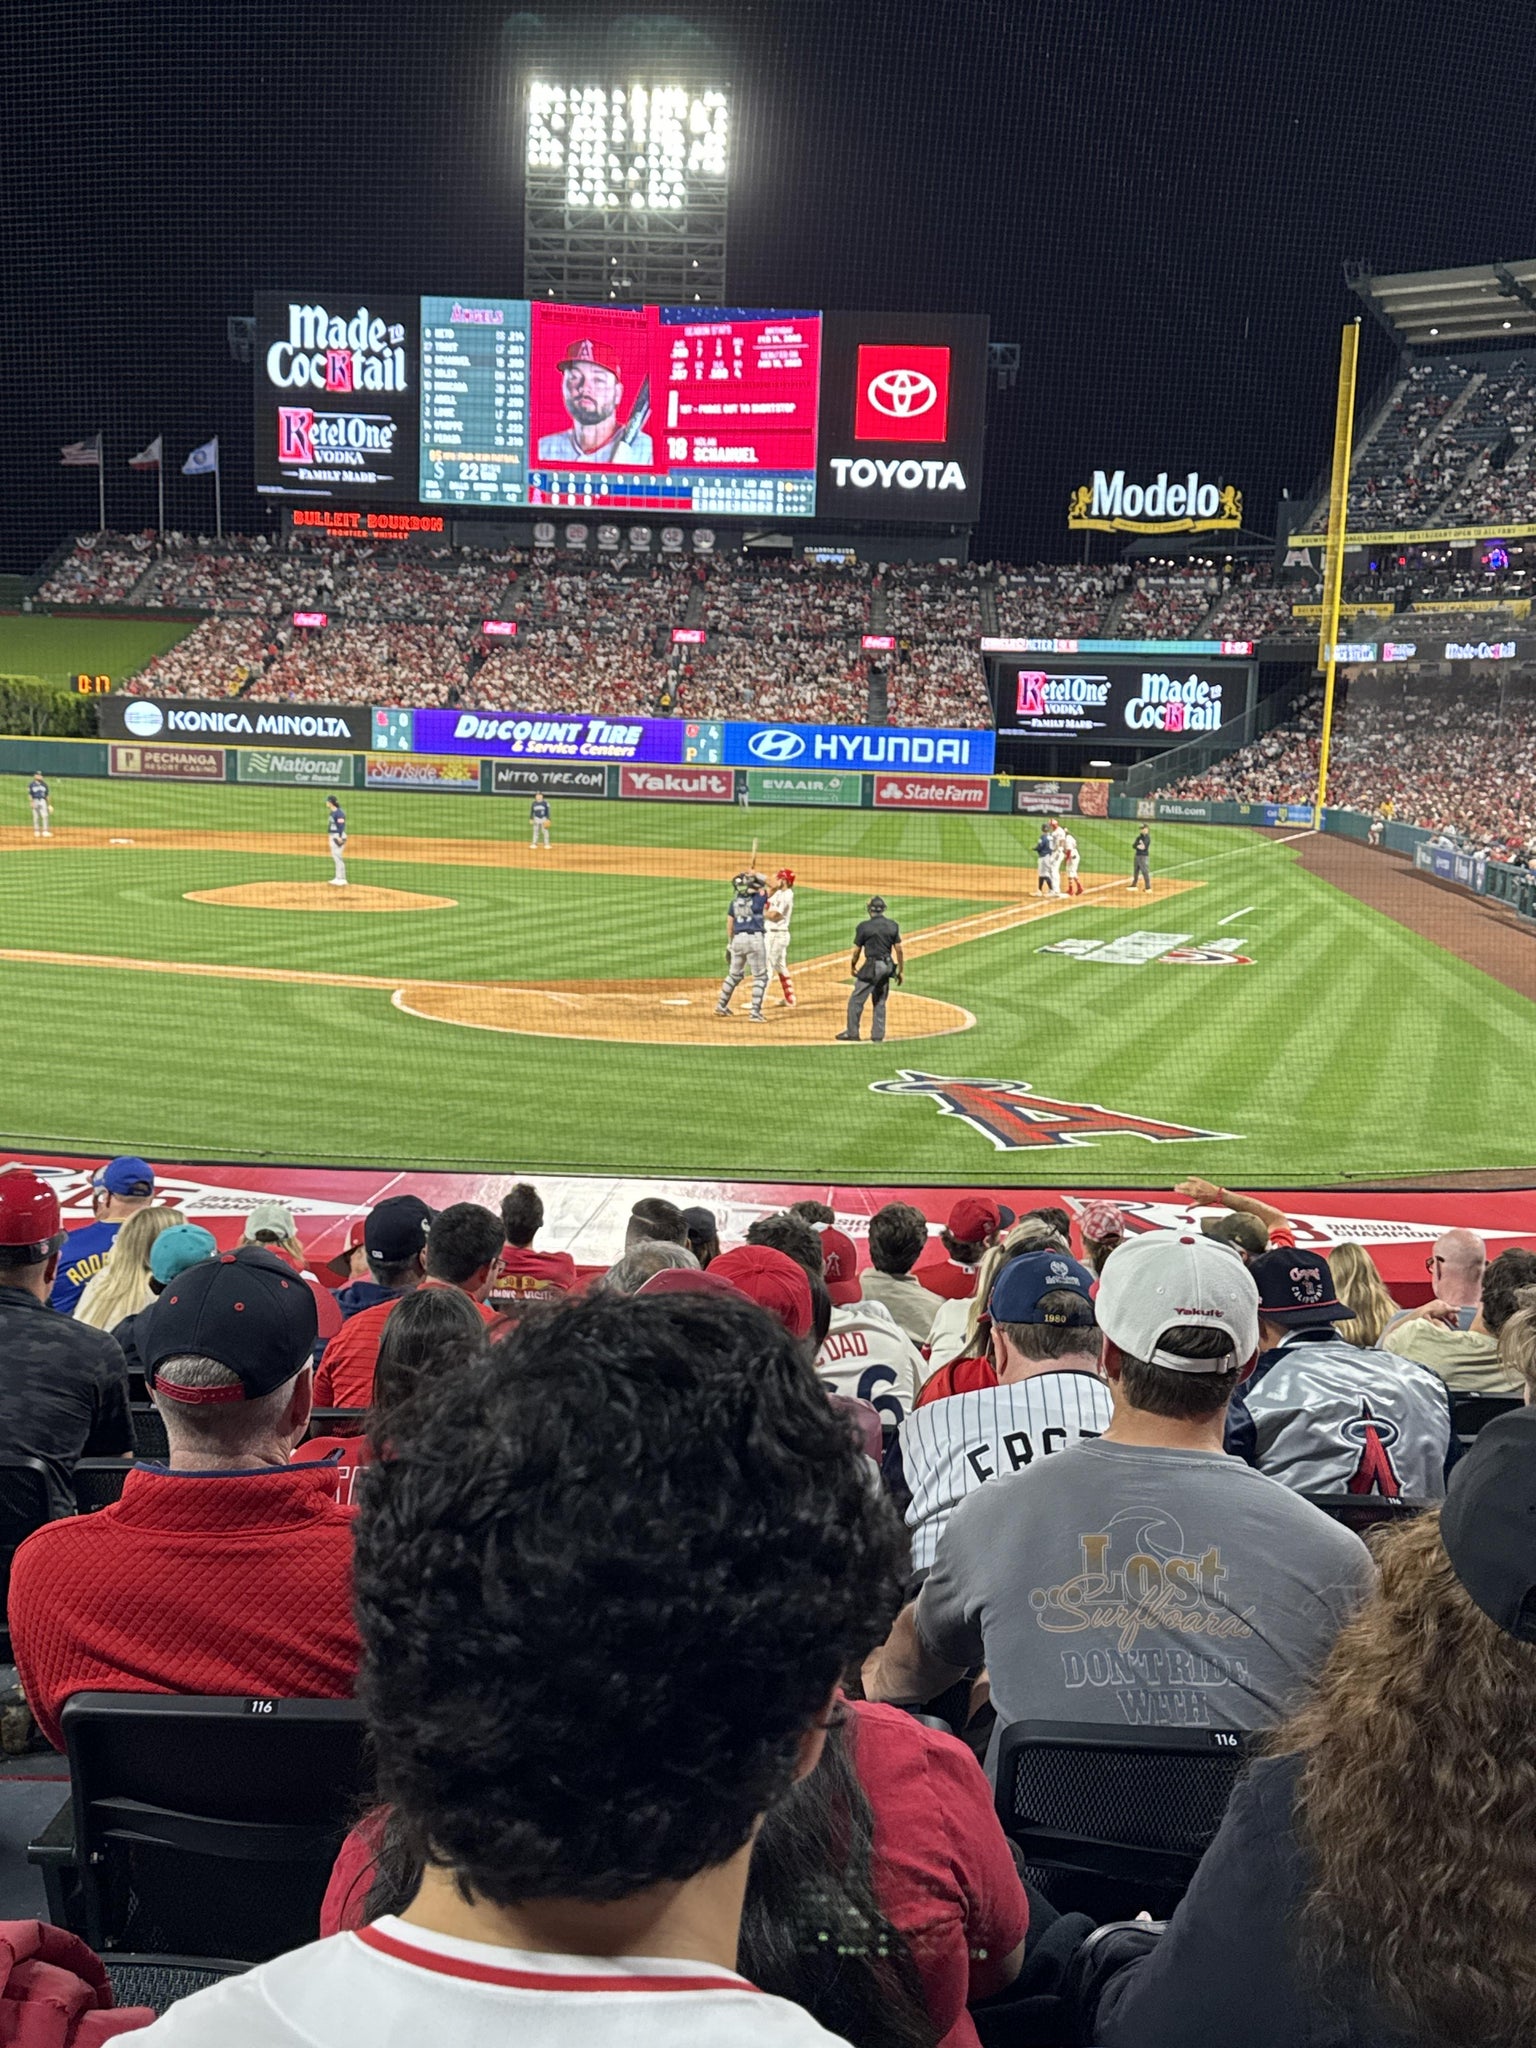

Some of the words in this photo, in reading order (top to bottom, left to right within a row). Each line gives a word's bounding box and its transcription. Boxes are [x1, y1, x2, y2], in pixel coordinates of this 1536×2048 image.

[289, 304, 388, 352] Made
[347, 417, 393, 449] One
[314, 451, 365, 465] VODKA
[667, 437, 688, 460] 18
[298, 468, 342, 481] FAMILY
[342, 470, 377, 483] MADE
[460, 462, 479, 480] 22
[830, 458, 967, 491] TOYOTA
[1091, 470, 1220, 517] Modelo
[293, 510, 361, 528] BULLEIT
[367, 513, 444, 532] BOURBON
[77, 675, 111, 694] 0:17
[1071, 678, 1108, 701] One
[1142, 673, 1210, 704] Made
[1045, 704, 1084, 715] VODKA
[168, 710, 253, 734] KONICA
[256, 714, 351, 738] MINOLTA
[454, 715, 583, 742] DISCOUNT
[586, 720, 643, 745] TIRE
[1031, 718, 1064, 728] FAMILY
[511, 740, 524, 752] &
[525, 741, 578, 755] Service
[580, 743, 636, 757] Centers
[814, 734, 970, 765] HYUNDAI
[144, 752, 217, 767] PECHANGA
[144, 764, 181, 772] RESORT
[183, 765, 217, 773] CASINO
[270, 754, 343, 775] National
[295, 773, 312, 781] Car
[314, 773, 340, 782] Rental
[372, 760, 437, 779] Surfside
[498, 768, 536, 783] NITTO
[542, 770, 603, 787] TIRE.COM
[628, 773, 726, 793] Yakult
[1160, 804, 1207, 816] FMB.com
[1326, 1223, 1412, 1231] DIVISION
[1044, 1313, 1067, 1323] 1980
[1174, 1306, 1225, 1319] Yakult
[1079, 1532, 1229, 1612] Lost
[1036, 1572, 1257, 1652] Surfboards
[1061, 1650, 1165, 1689] DON'T
[1168, 1650, 1249, 1688] RIDE
[252, 1700, 273, 1714] 116
[1117, 1689, 1211, 1726] WITH
[1214, 1733, 1238, 1747] 116
